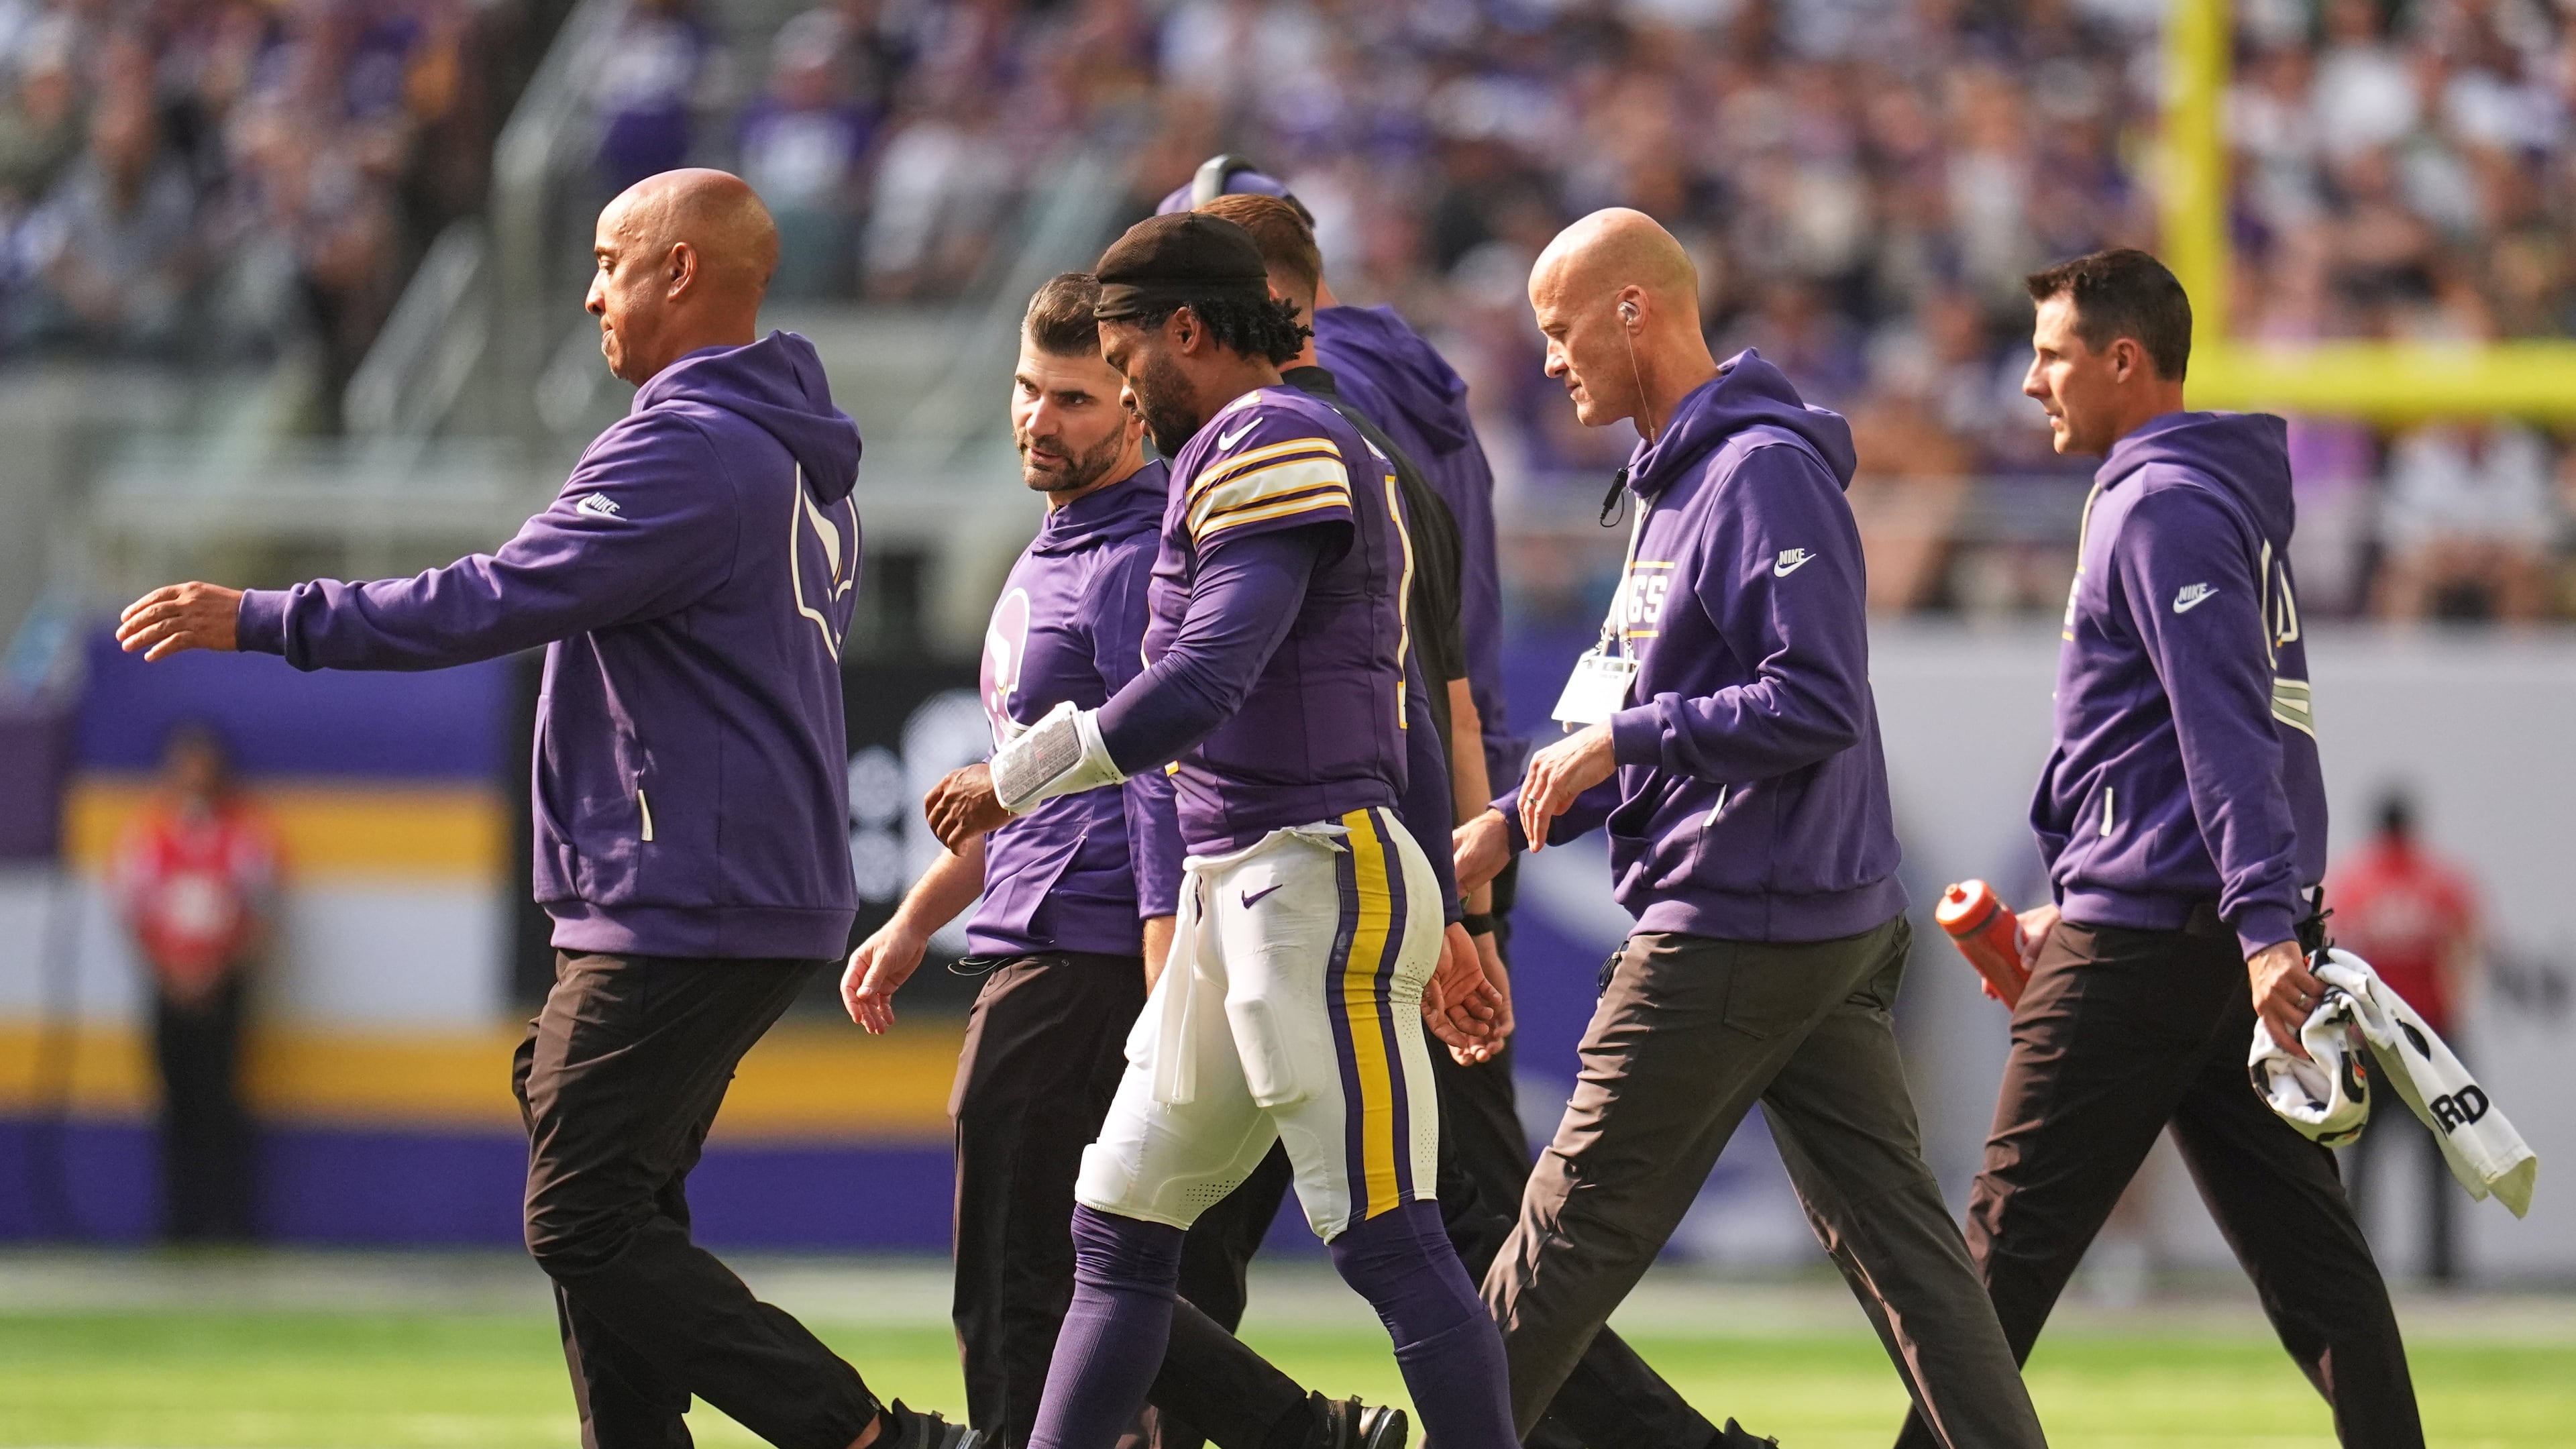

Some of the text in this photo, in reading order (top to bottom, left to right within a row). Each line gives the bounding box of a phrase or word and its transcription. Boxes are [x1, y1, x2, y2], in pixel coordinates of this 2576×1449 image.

[586, 492, 621, 515] NIKE
[1779, 547, 1805, 566] NIKE
[2178, 582, 2208, 602] NIKE
